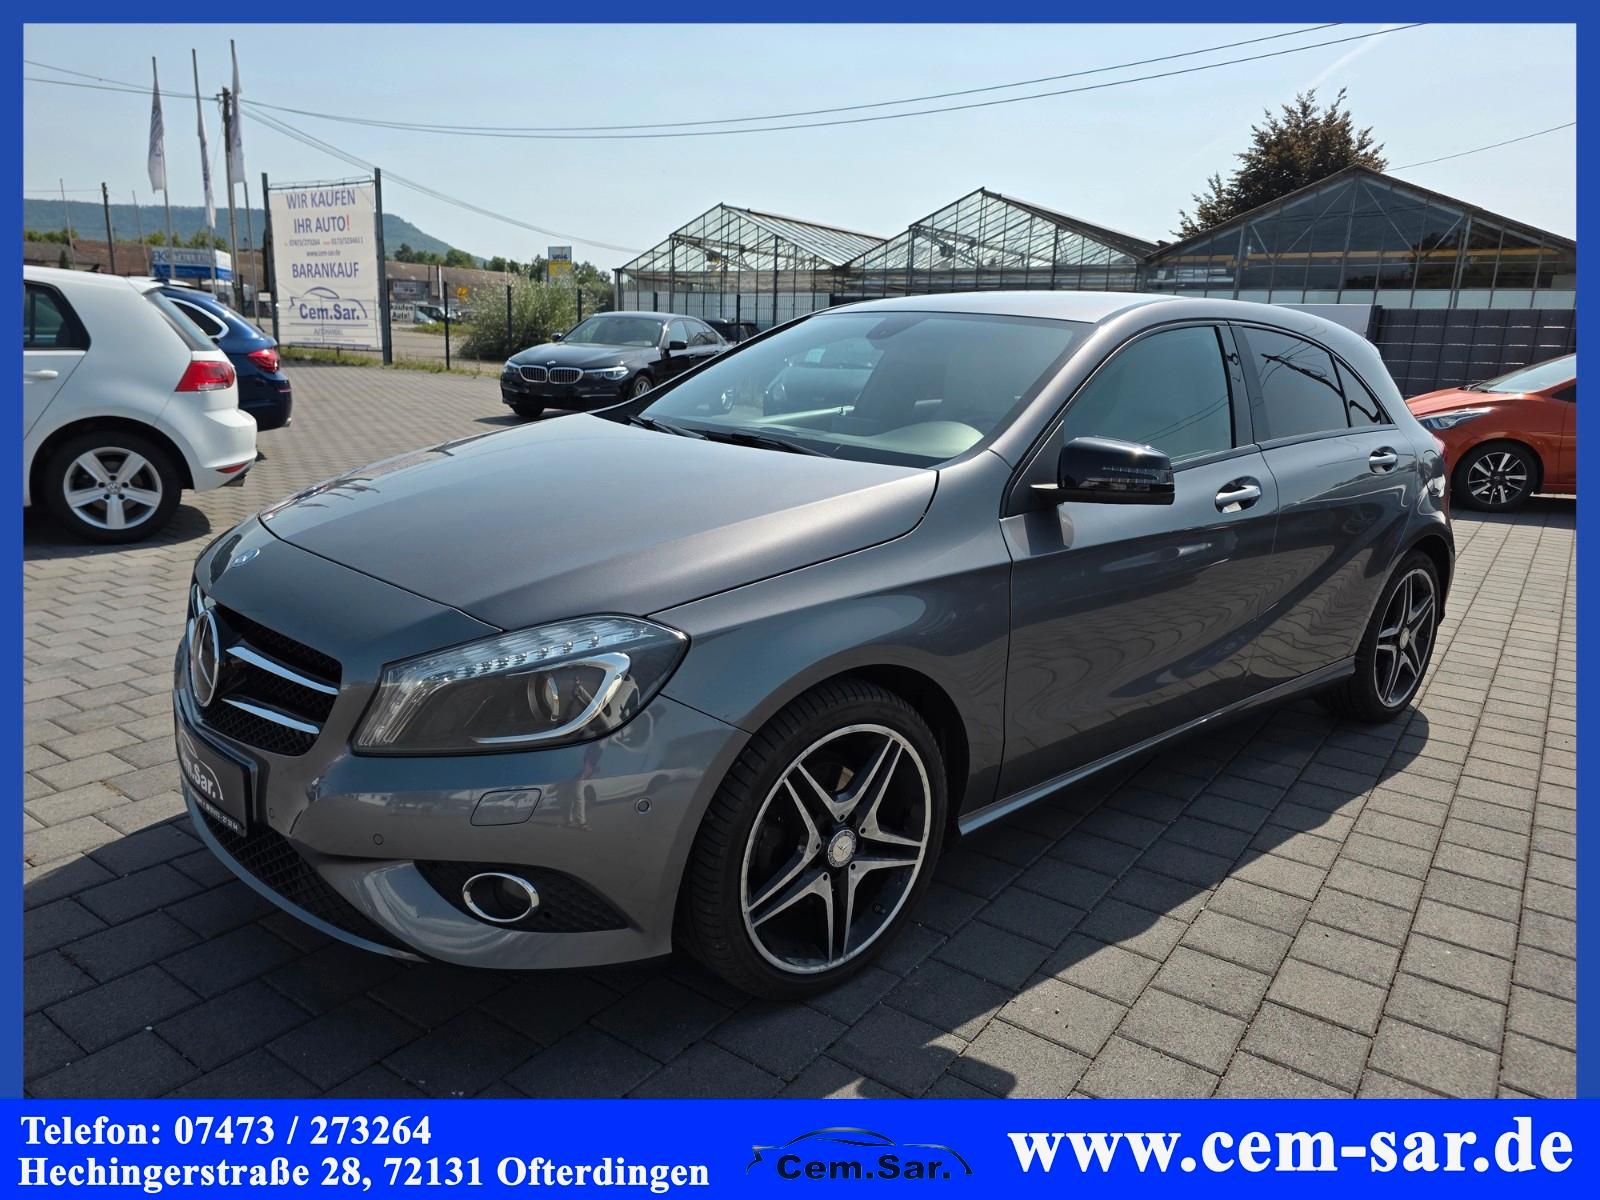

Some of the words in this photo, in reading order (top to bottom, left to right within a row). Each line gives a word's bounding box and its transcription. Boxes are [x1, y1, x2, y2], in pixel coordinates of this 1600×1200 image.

[286, 191, 308, 209] WIR
[310, 189, 356, 208] KAUFEN
[293, 217, 312, 234] IHR
[315, 214, 350, 233] AUTO!
[291, 261, 360, 279] BARANKAUF
[299, 302, 361, 321] Cem.Sar.
